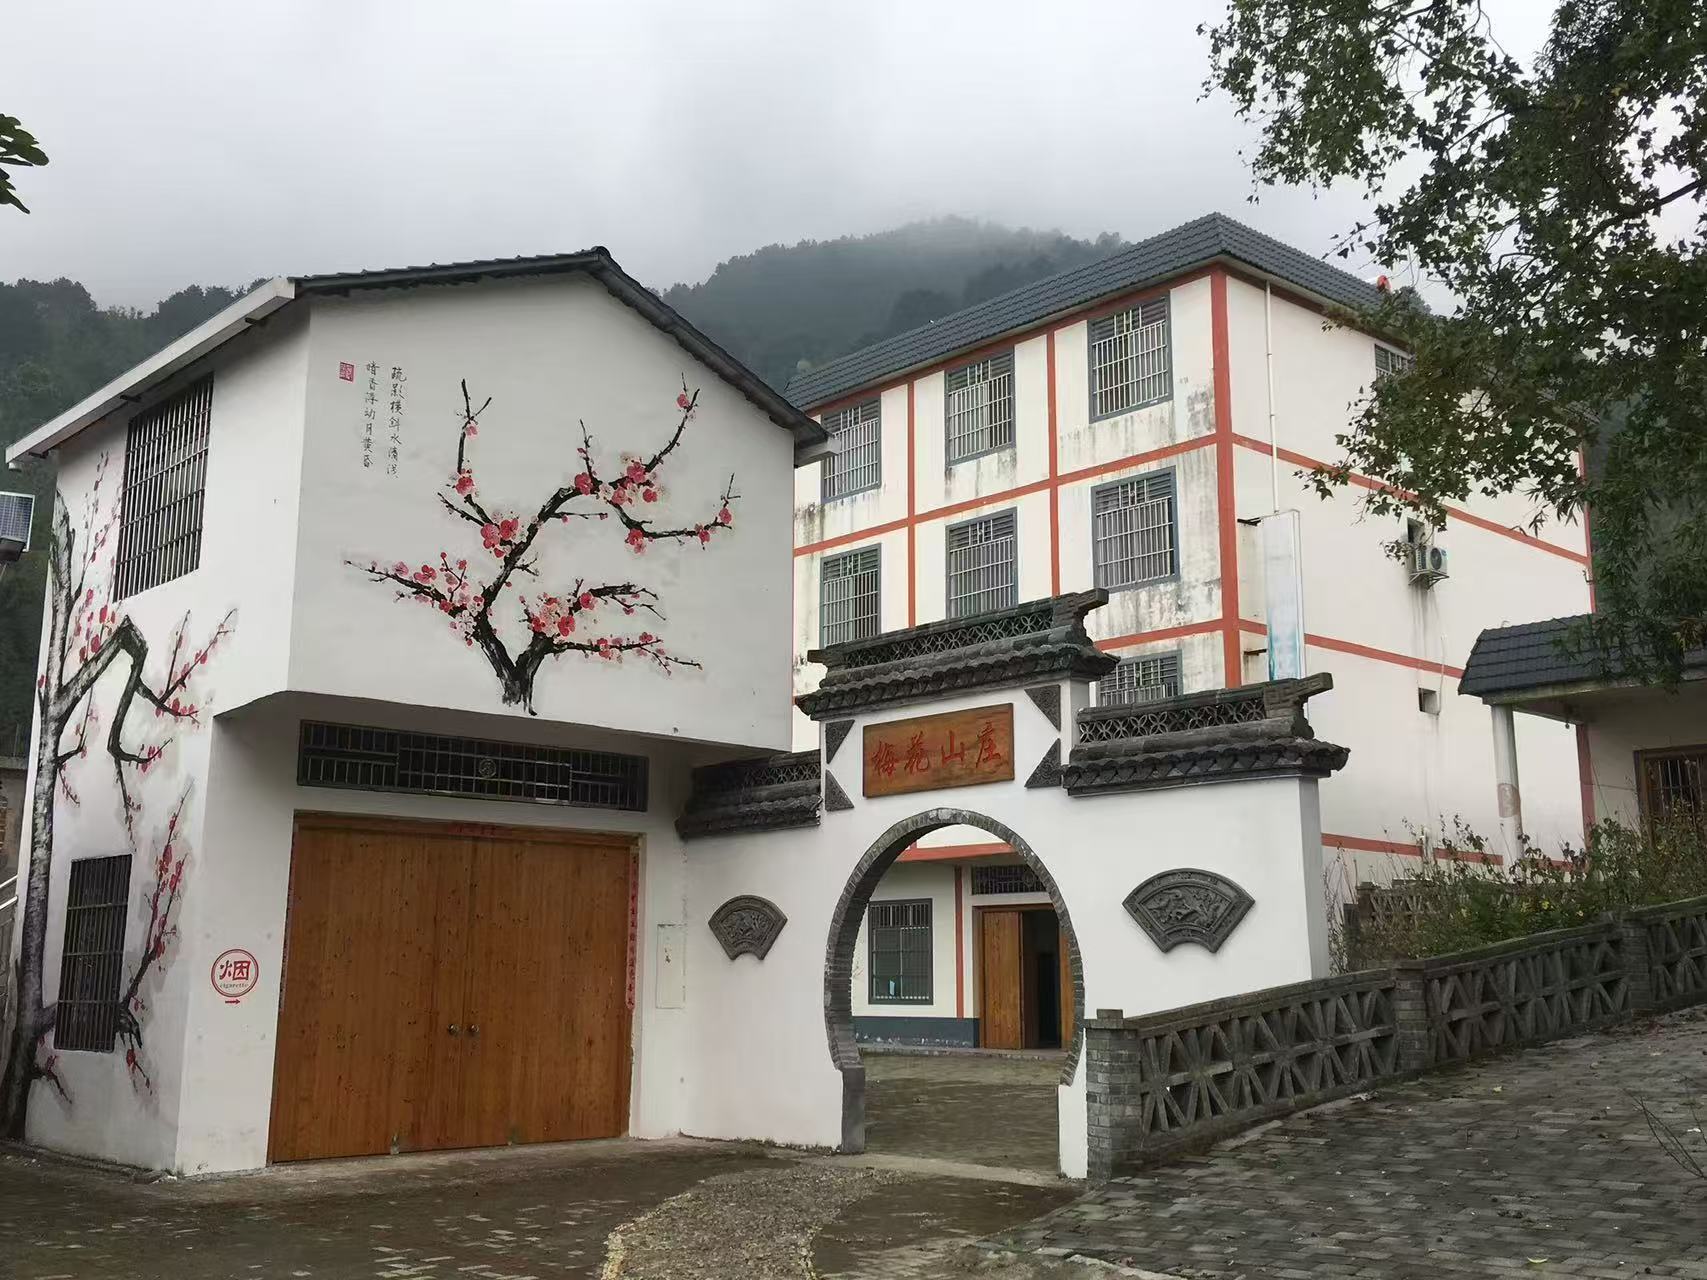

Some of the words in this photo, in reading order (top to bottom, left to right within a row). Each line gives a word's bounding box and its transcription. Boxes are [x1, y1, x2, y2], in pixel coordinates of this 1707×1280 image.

[871, 720, 1001, 777] 梅花山庄
[219, 959, 251, 981] 烟
